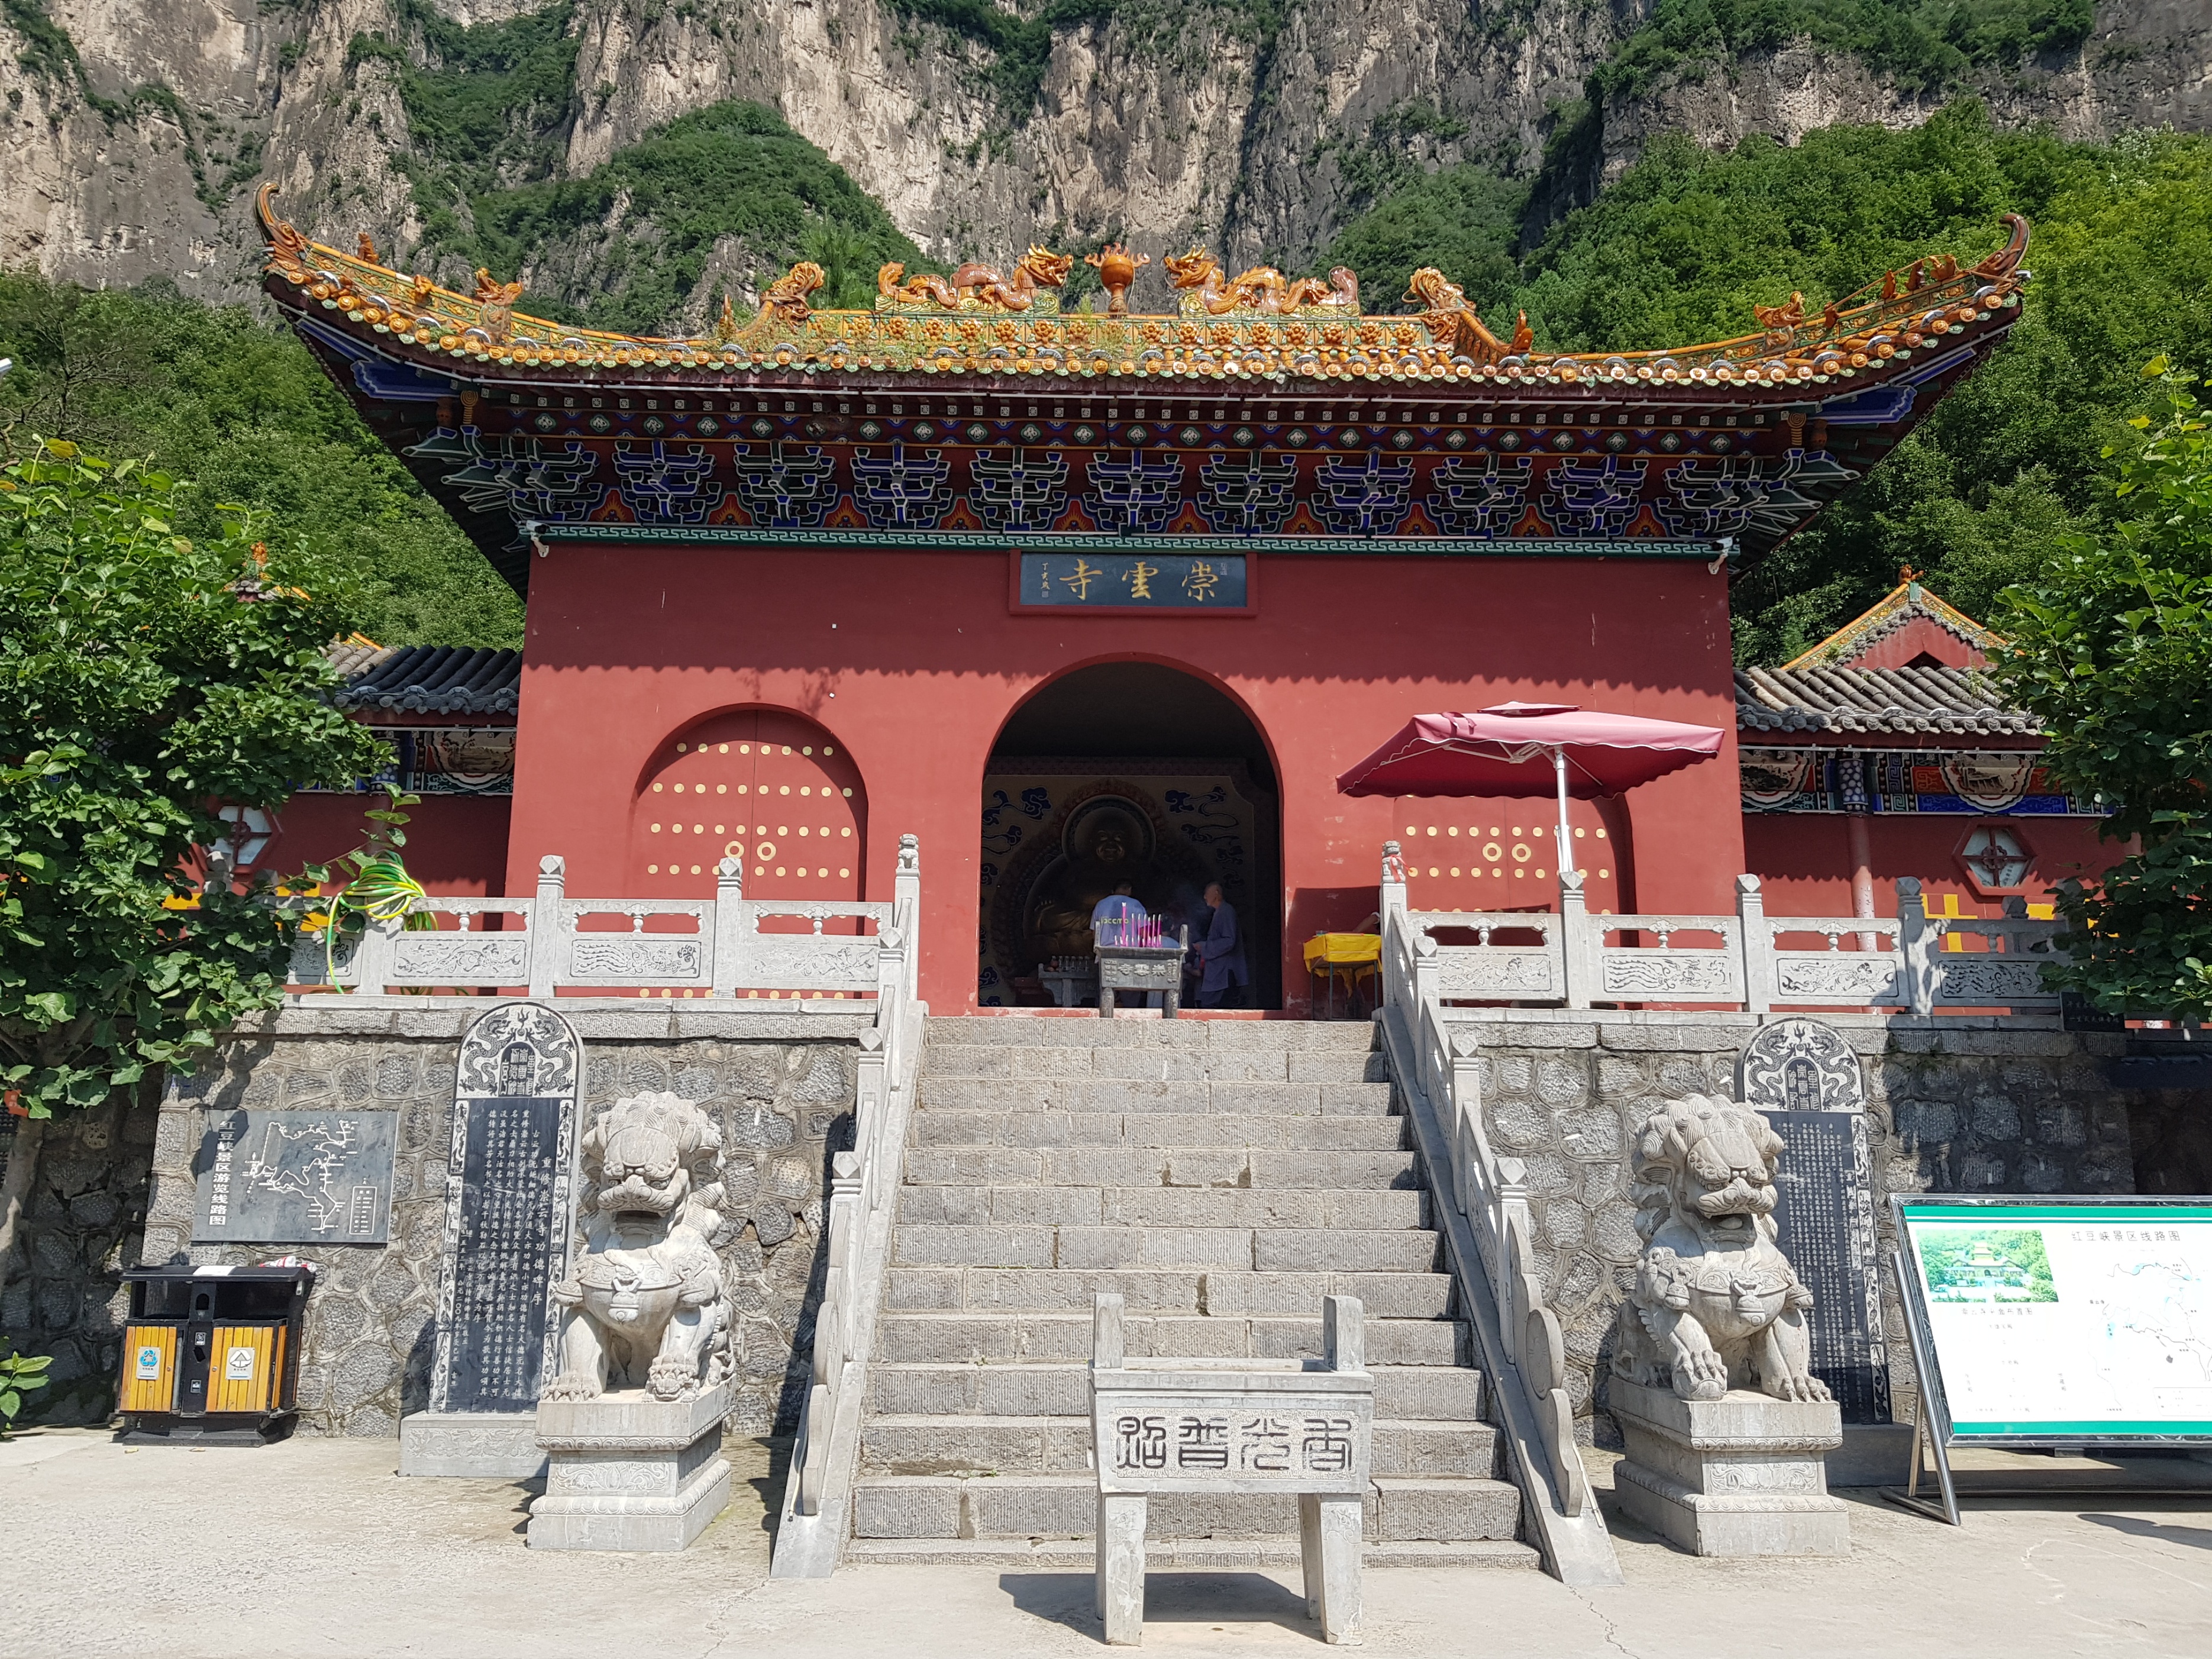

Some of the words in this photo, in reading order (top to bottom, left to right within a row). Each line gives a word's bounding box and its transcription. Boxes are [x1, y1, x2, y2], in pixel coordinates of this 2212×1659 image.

[209, 1120, 235, 1226] 红豆峡景区游览线路图
[529, 1156, 553, 1305] 重修崇云寺功德碑序
[2071, 1230, 2181, 1242] 红豆峡景区线路图
